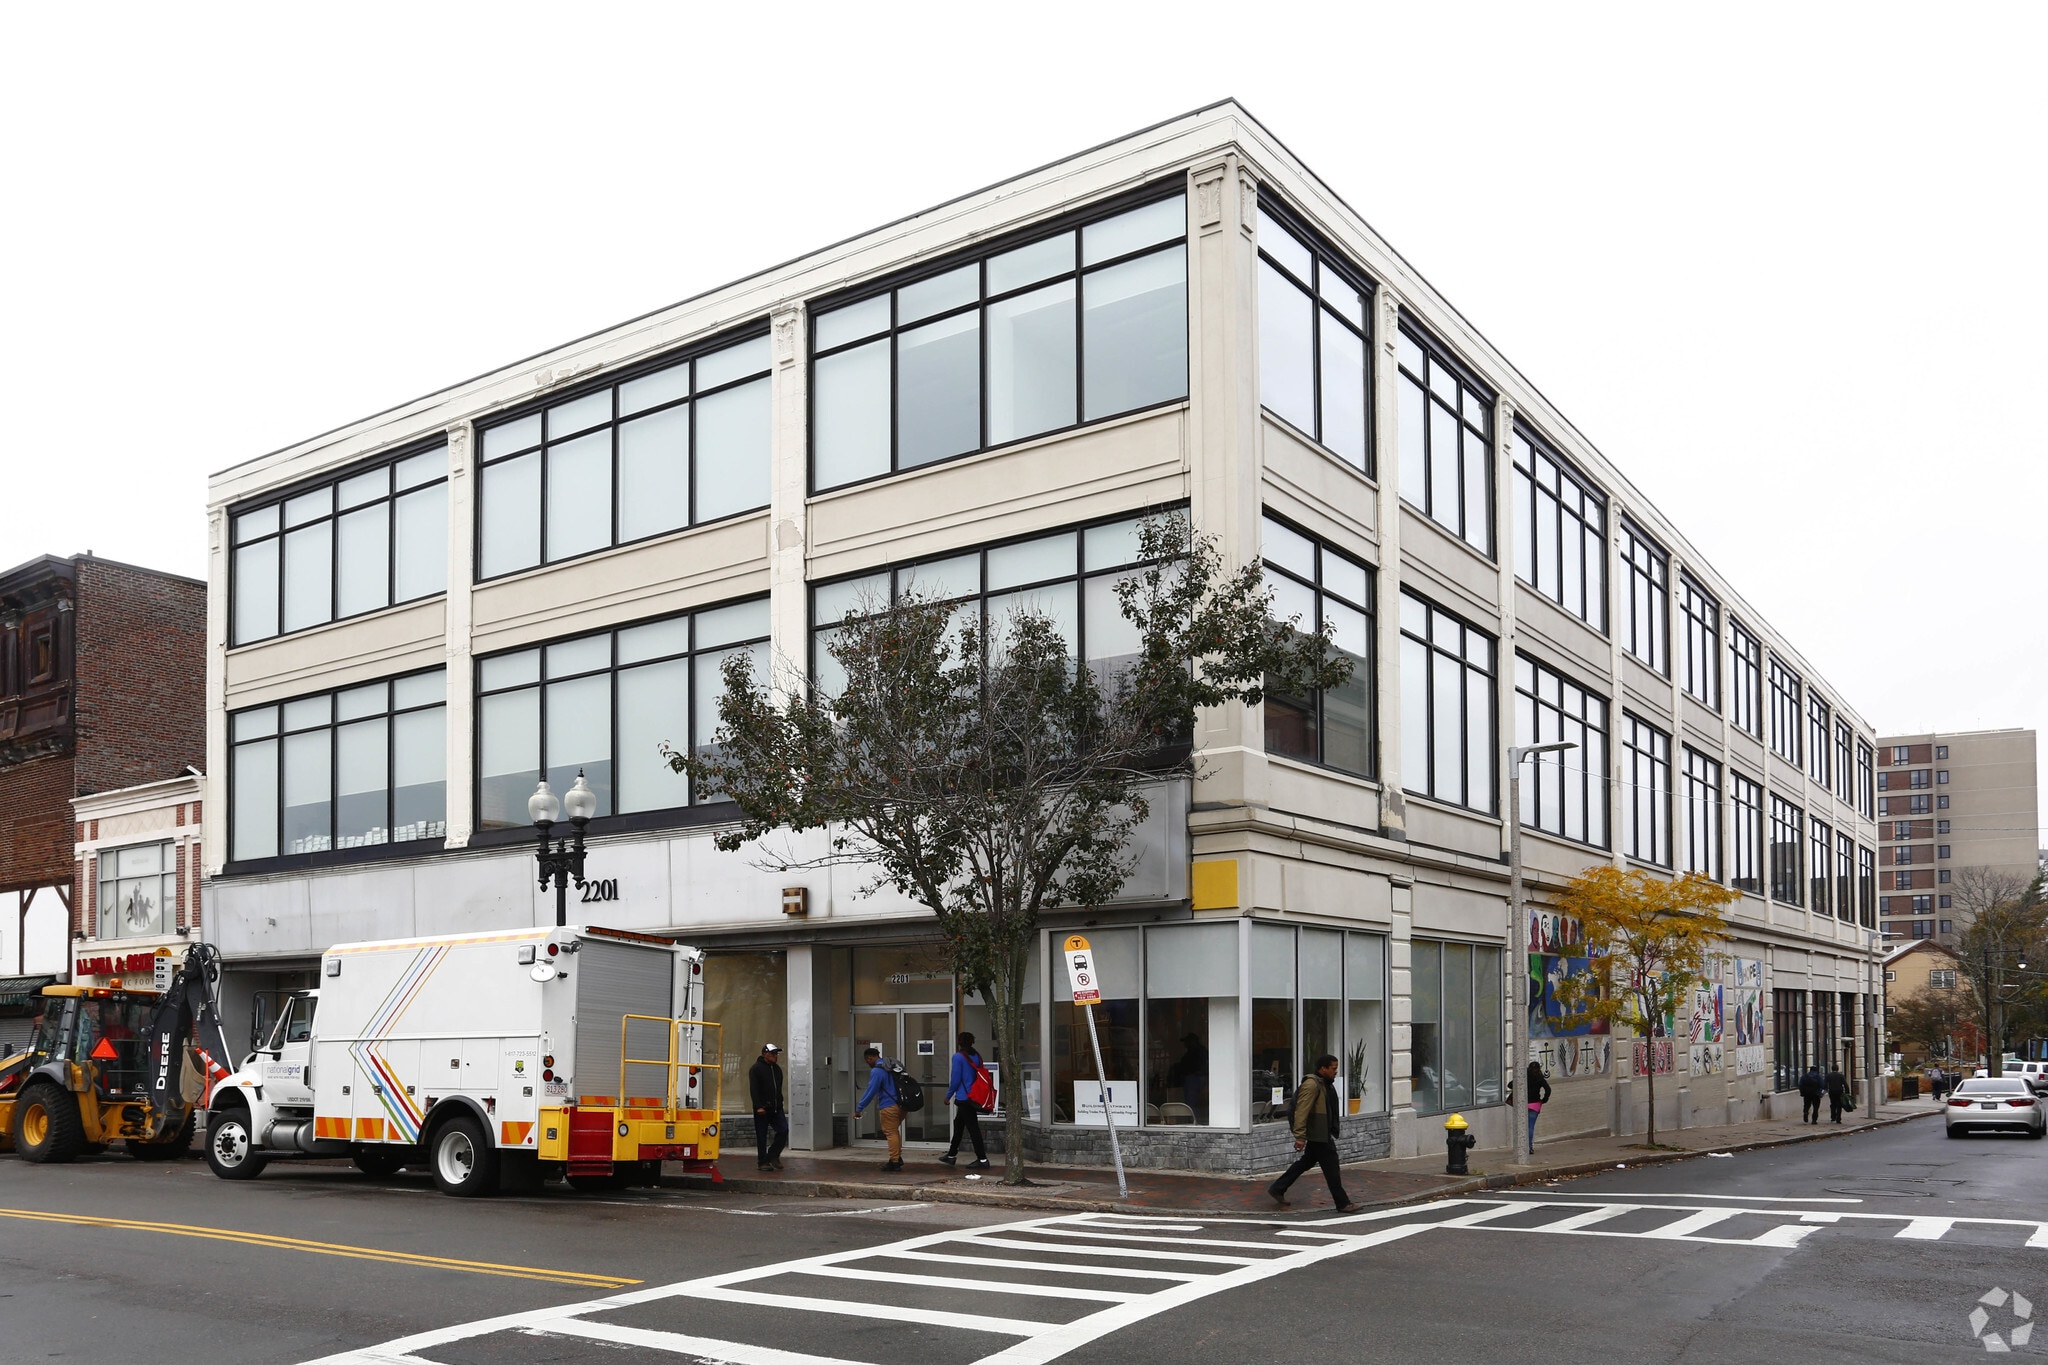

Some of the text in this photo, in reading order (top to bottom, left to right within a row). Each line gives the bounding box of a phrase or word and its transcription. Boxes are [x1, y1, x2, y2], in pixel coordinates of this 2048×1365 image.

[581, 878, 619, 902] 2201
[76, 952, 155, 976] ALPHA & OMEG
[892, 974, 909, 983] 2201
[155, 1032, 170, 1090] DEERE
[267, 1064, 301, 1076] nationalgrid
